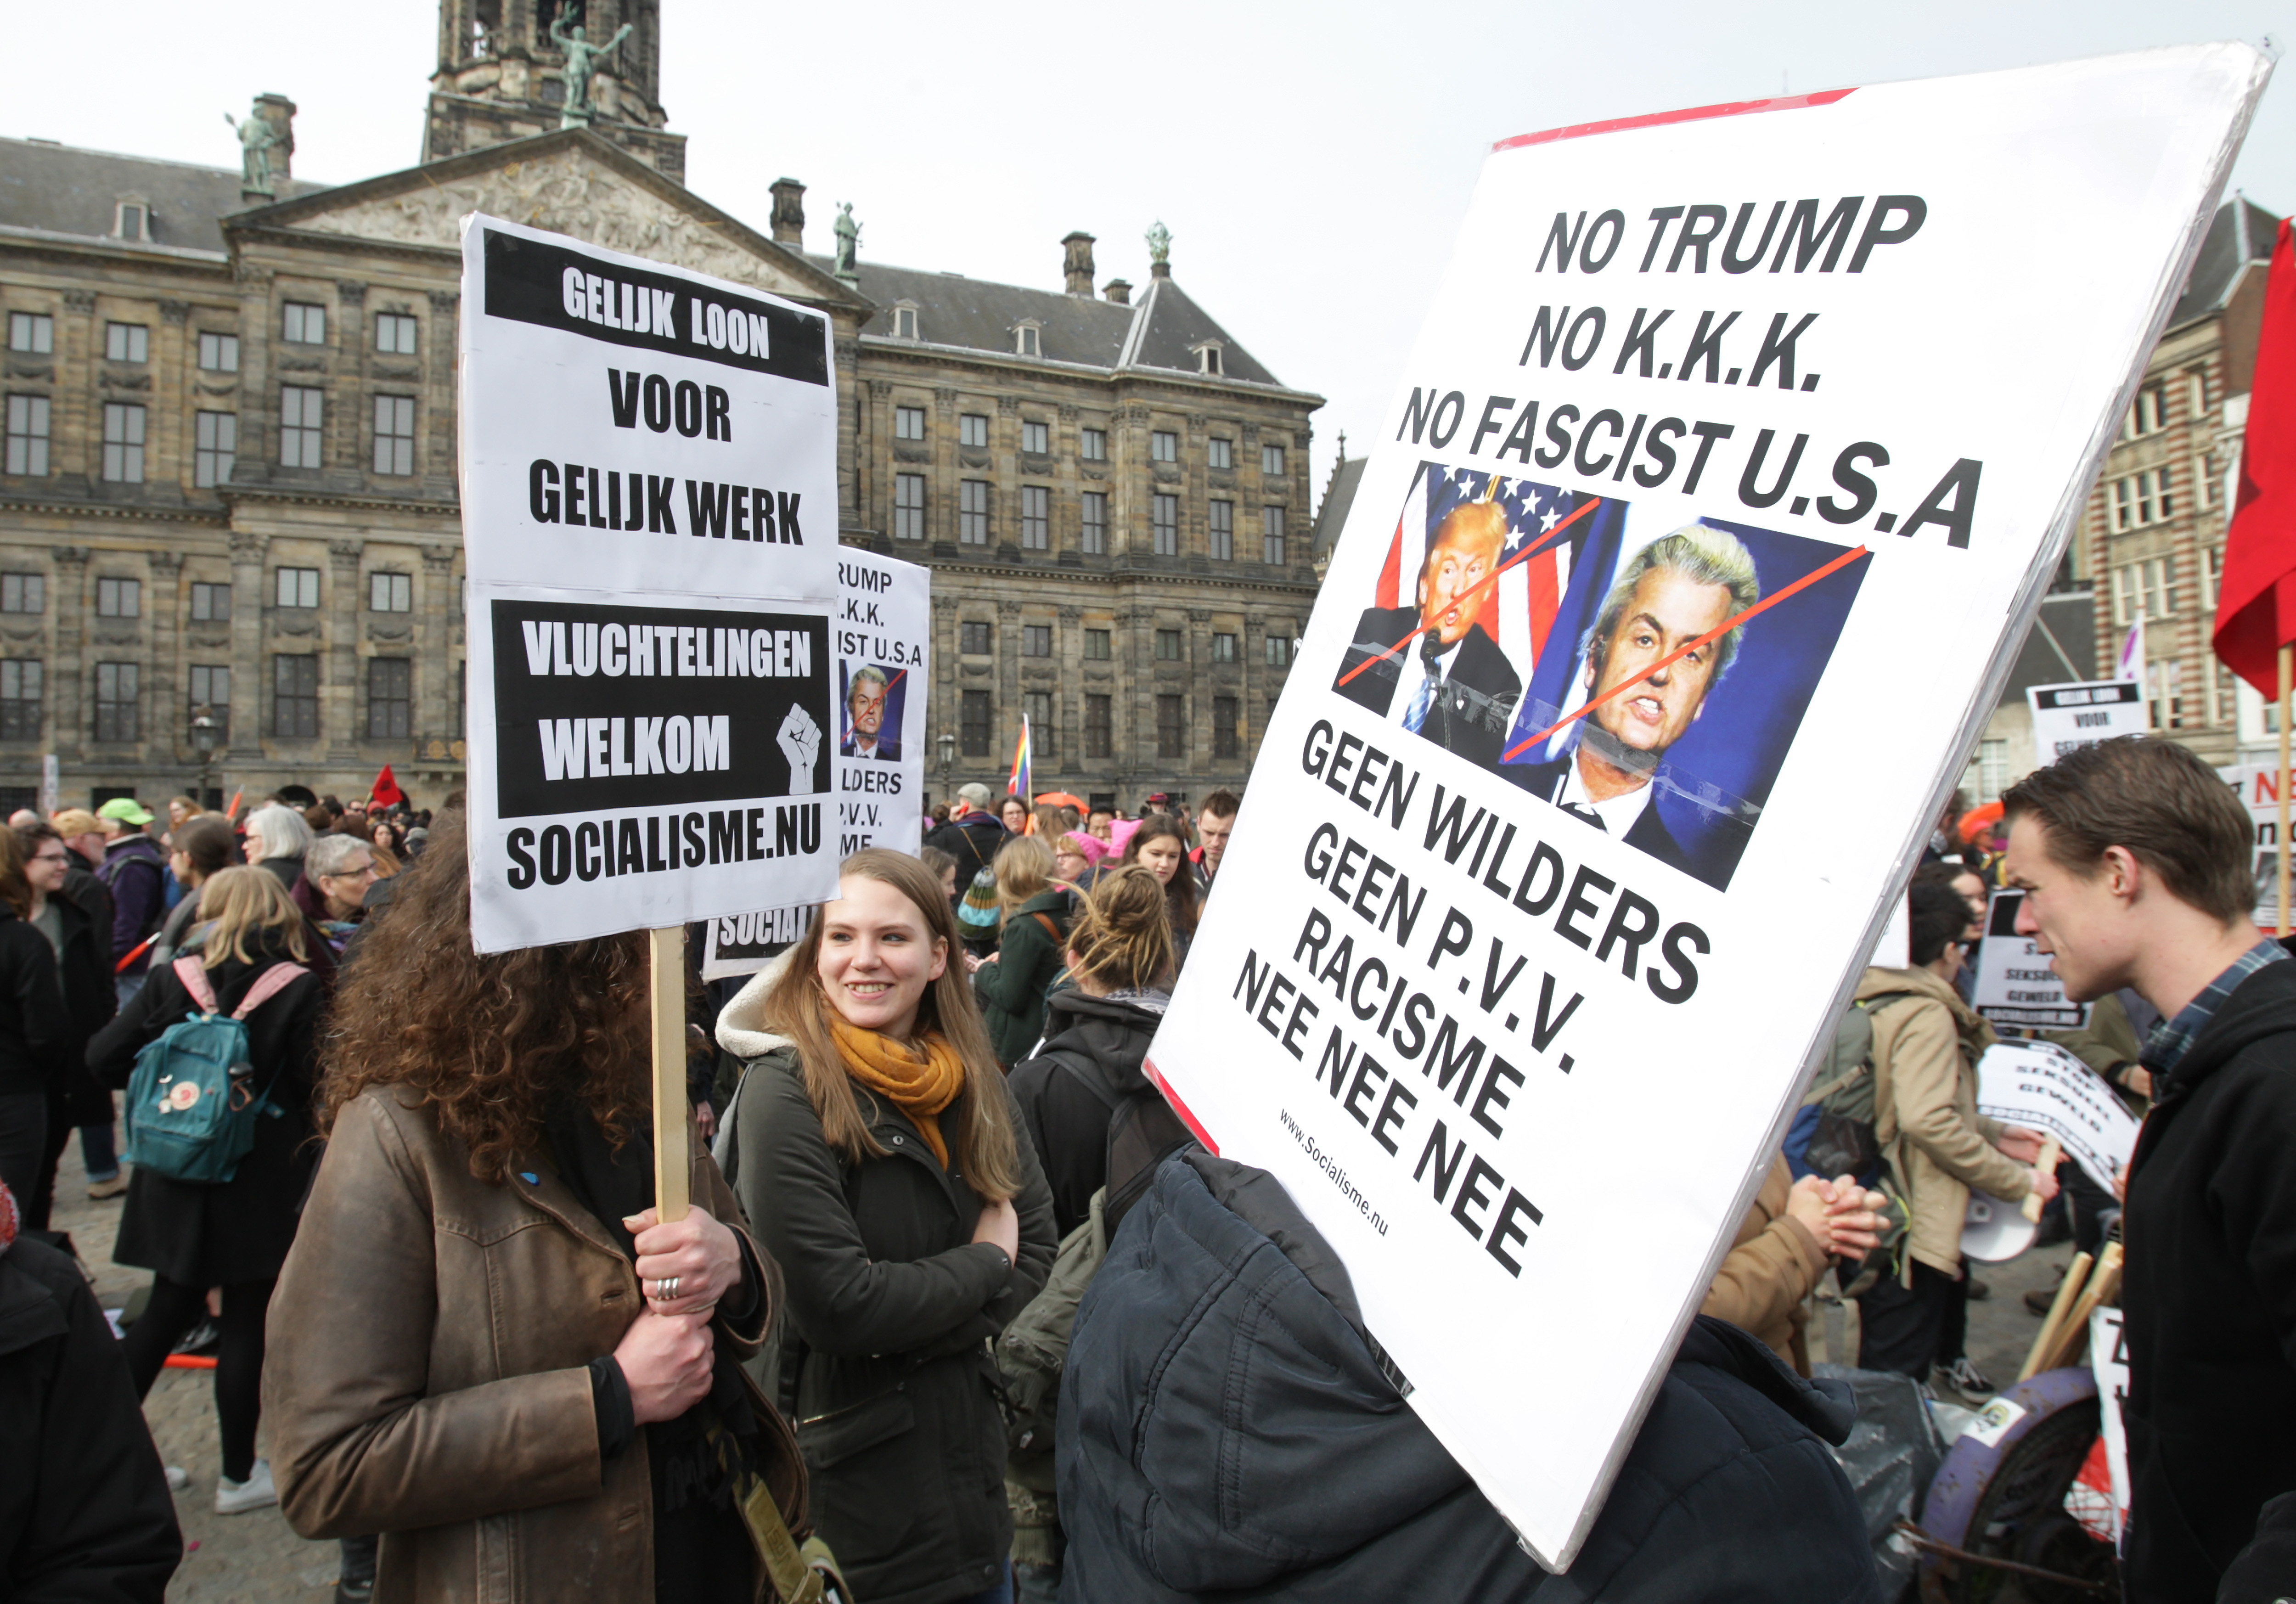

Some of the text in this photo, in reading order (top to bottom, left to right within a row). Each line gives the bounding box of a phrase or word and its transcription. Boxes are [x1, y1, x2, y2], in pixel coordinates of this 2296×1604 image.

[1535, 195, 1927, 275] NO TRUMP
[563, 267, 769, 359] GELIJK LOON
[1520, 305, 1820, 392] NO K.K.K.
[608, 368, 731, 442] VOOR
[529, 459, 803, 546] GELIJK WERK
[1396, 386, 1984, 550] NO FASCIST U.S.A
[522, 620, 810, 678] VLUCHTELINGEN
[837, 595, 884, 627] .K.K.
[838, 630, 922, 667] IST U.S.A
[539, 715, 729, 781] WELKOM
[842, 768, 902, 795] LDERS
[506, 803, 821, 889] SOCIALISME.NU
[840, 834, 872, 856] ME
[1302, 719, 1711, 1005] GEEN WILDERS
[720, 906, 816, 946] SOCIAL
[1304, 822, 1585, 1075] GEEN P.V.V.
[1293, 907, 1525, 1140] RACISME
[1232, 948, 1544, 1279] NEE NEE NEE
[1280, 1108, 1389, 1237] www.Socialisme.nu
